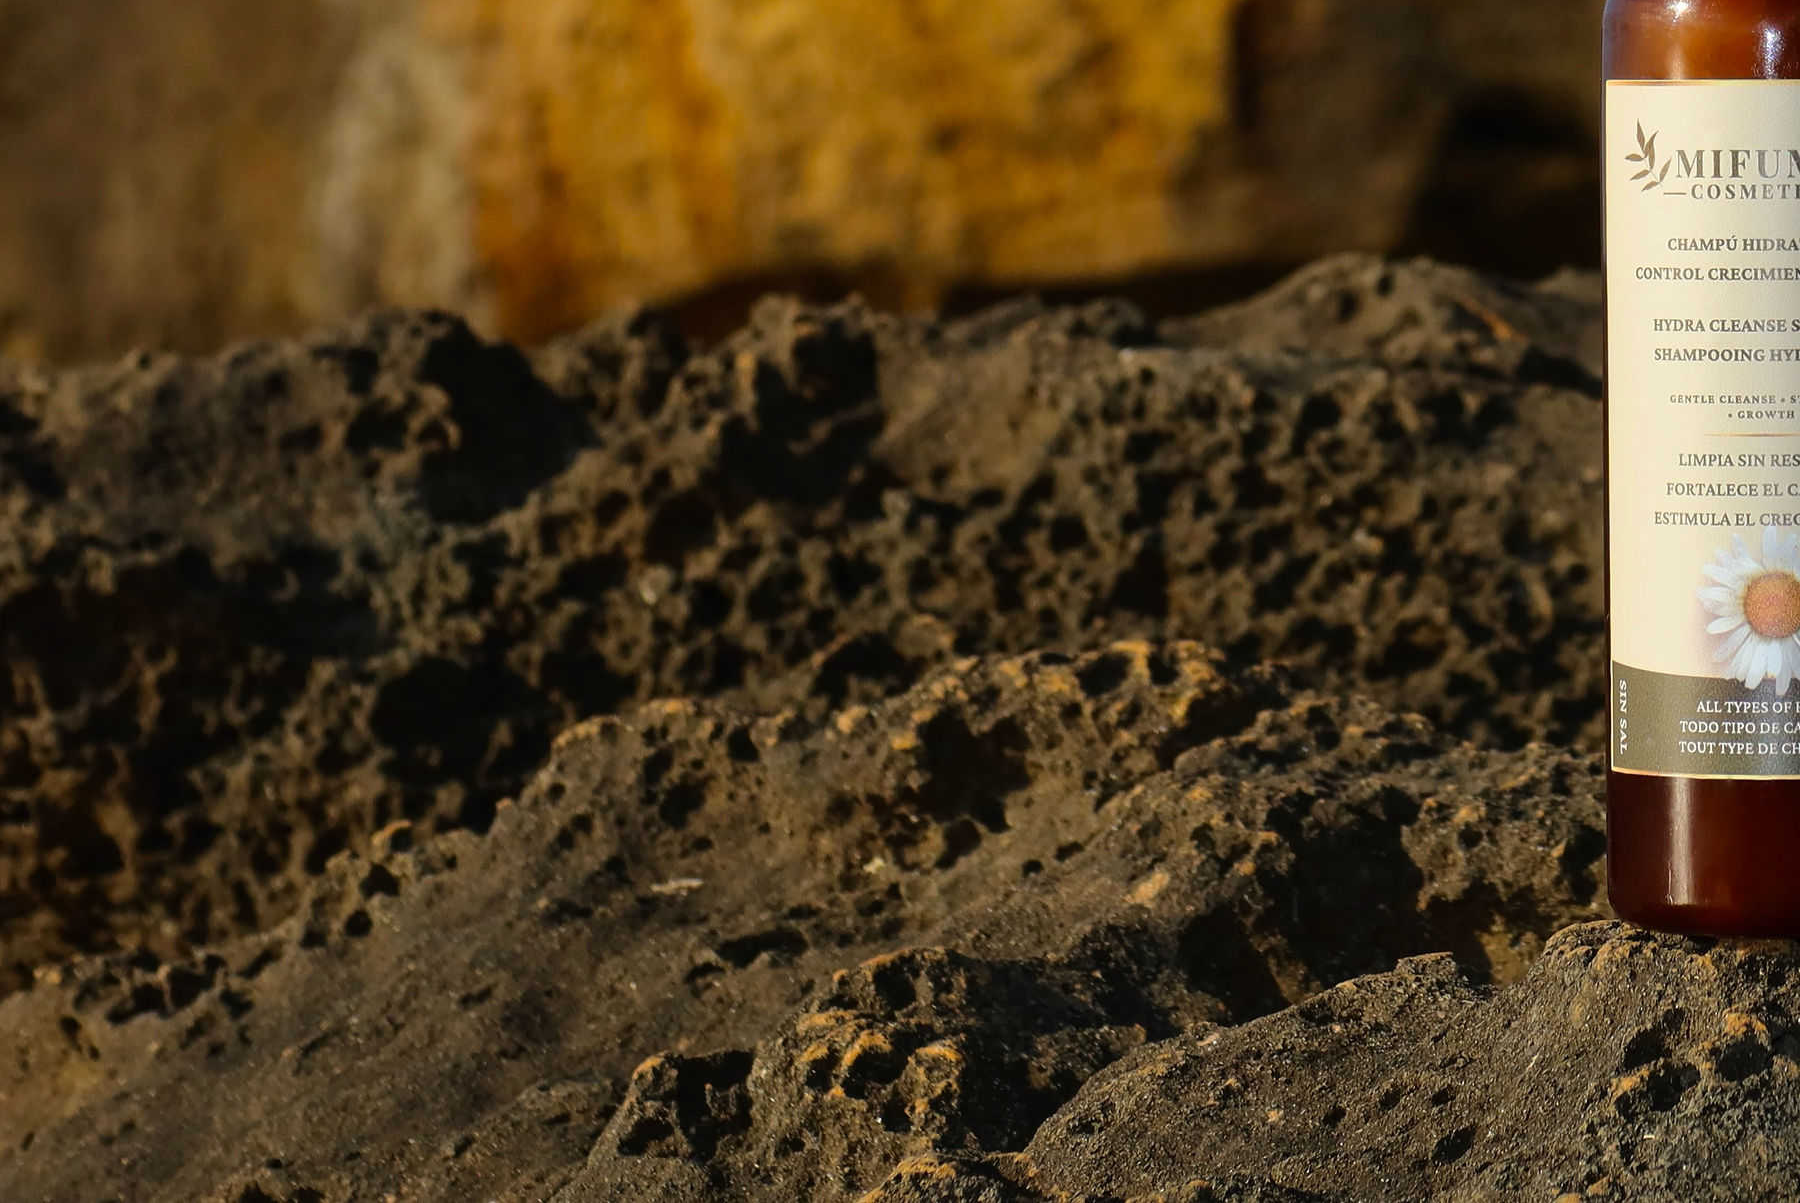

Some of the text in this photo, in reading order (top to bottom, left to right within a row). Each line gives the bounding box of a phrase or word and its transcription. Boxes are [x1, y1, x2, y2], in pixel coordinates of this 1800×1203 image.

[1667, 235, 1739, 252] CHAMPÚ
[1635, 266, 1704, 281] CONTROL
[1653, 318, 1706, 333] HYDRA
[1709, 318, 1787, 333] CLEANSE
[1654, 348, 1766, 362] SHAMPOOING
[1669, 394, 1715, 404] GENTLE
[1719, 394, 1776, 404] CLEANSE
[1737, 410, 1795, 419] GROWTH
[1678, 453, 1734, 467] LIMPIA
[1737, 453, 1765, 467] SIN
[1666, 482, 1758, 496] FORTALECE
[1762, 483, 1783, 496] EL
[1654, 511, 1731, 526] ESTIMULA
[1734, 512, 1755, 526] EL
[1696, 701, 1722, 713] ALL
[1724, 701, 1769, 714] TYPES
[1772, 701, 1792, 714] OF
[1619, 679, 1628, 755] SIN SAL
[1679, 720, 1719, 734] TODO
[1722, 721, 1756, 734] TIPO
[1760, 722, 1780, 734] DE
[1679, 741, 1717, 754] TOUT
[1718, 741, 1754, 755] TYPE
[1756, 742, 1778, 755] DE
